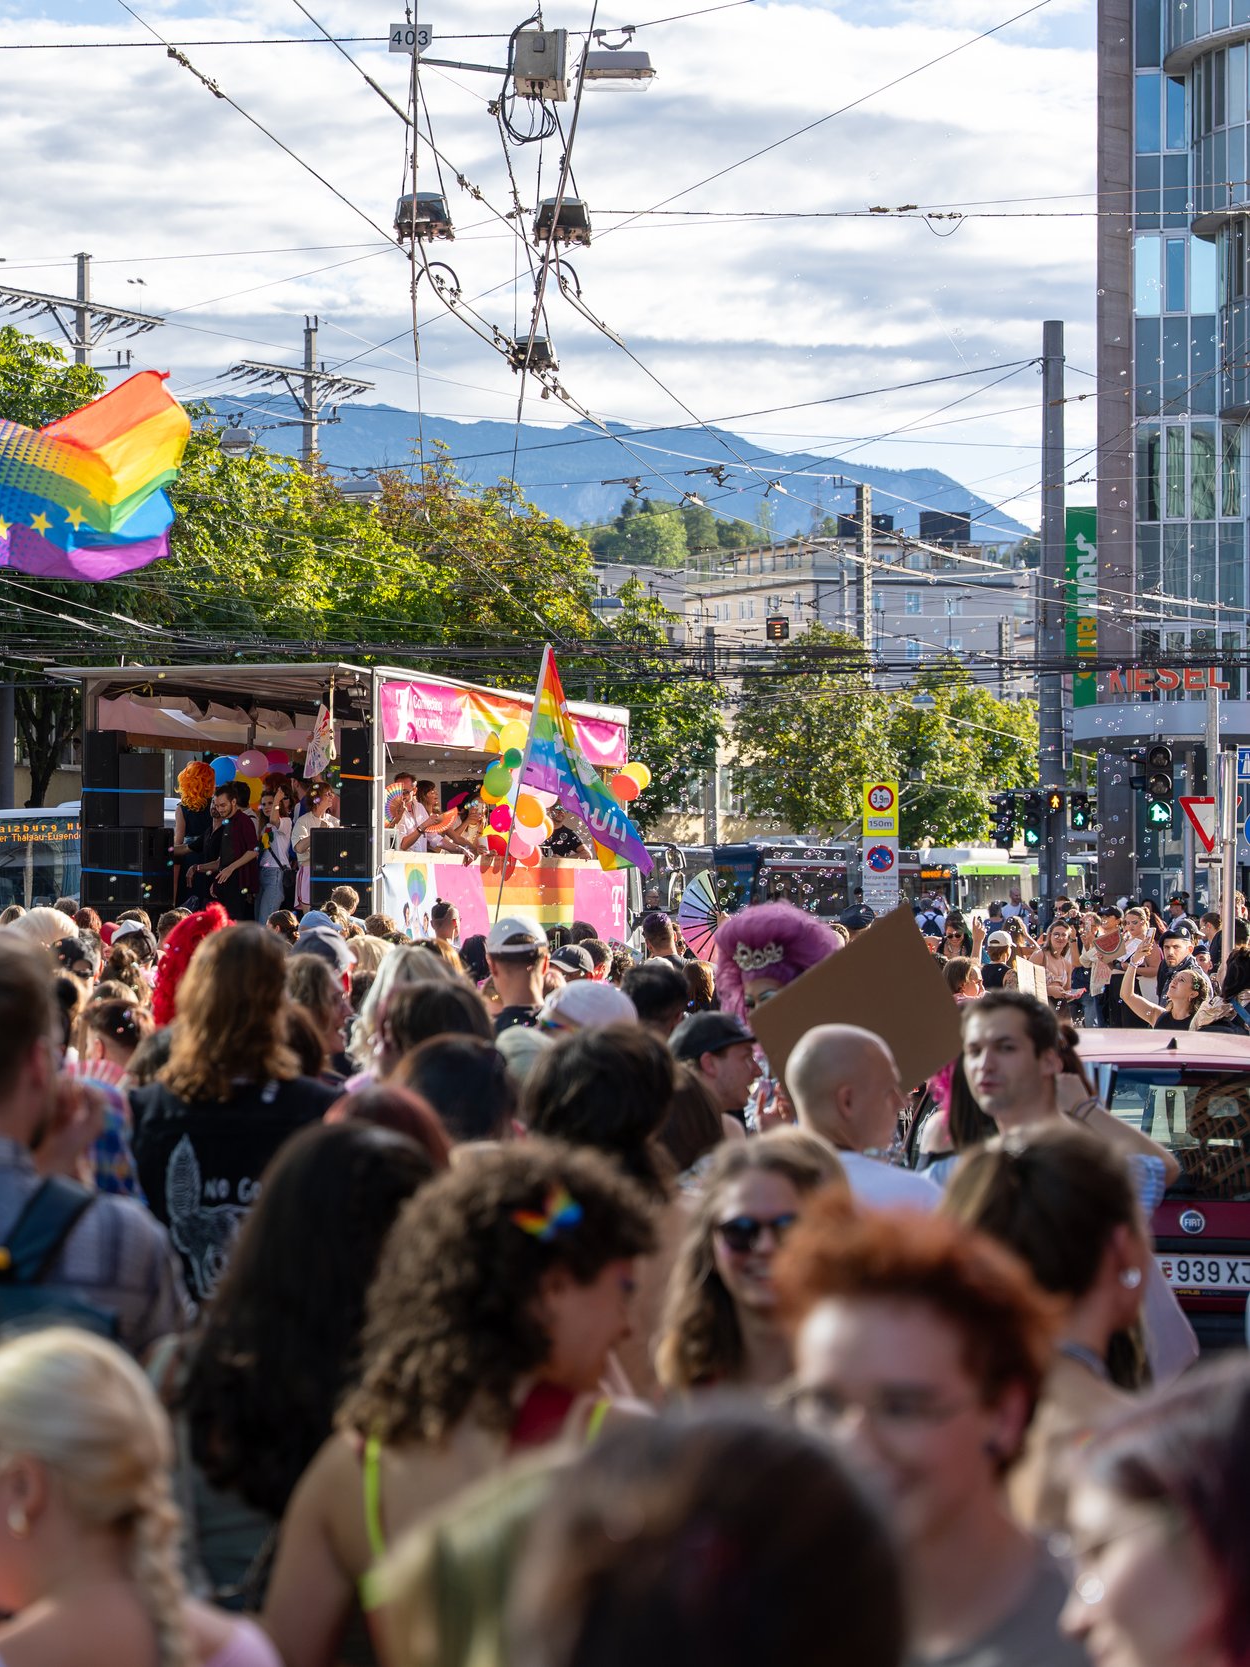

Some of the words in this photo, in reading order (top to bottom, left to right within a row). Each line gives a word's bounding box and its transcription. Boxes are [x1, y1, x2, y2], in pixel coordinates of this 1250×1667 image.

[391, 30, 428, 46] 403
[1109, 666, 1230, 692] KIESEL
[868, 820, 893, 828] 150m
[1184, 1218, 1201, 1227] FIAT
[1177, 1260, 1221, 1284] 939
